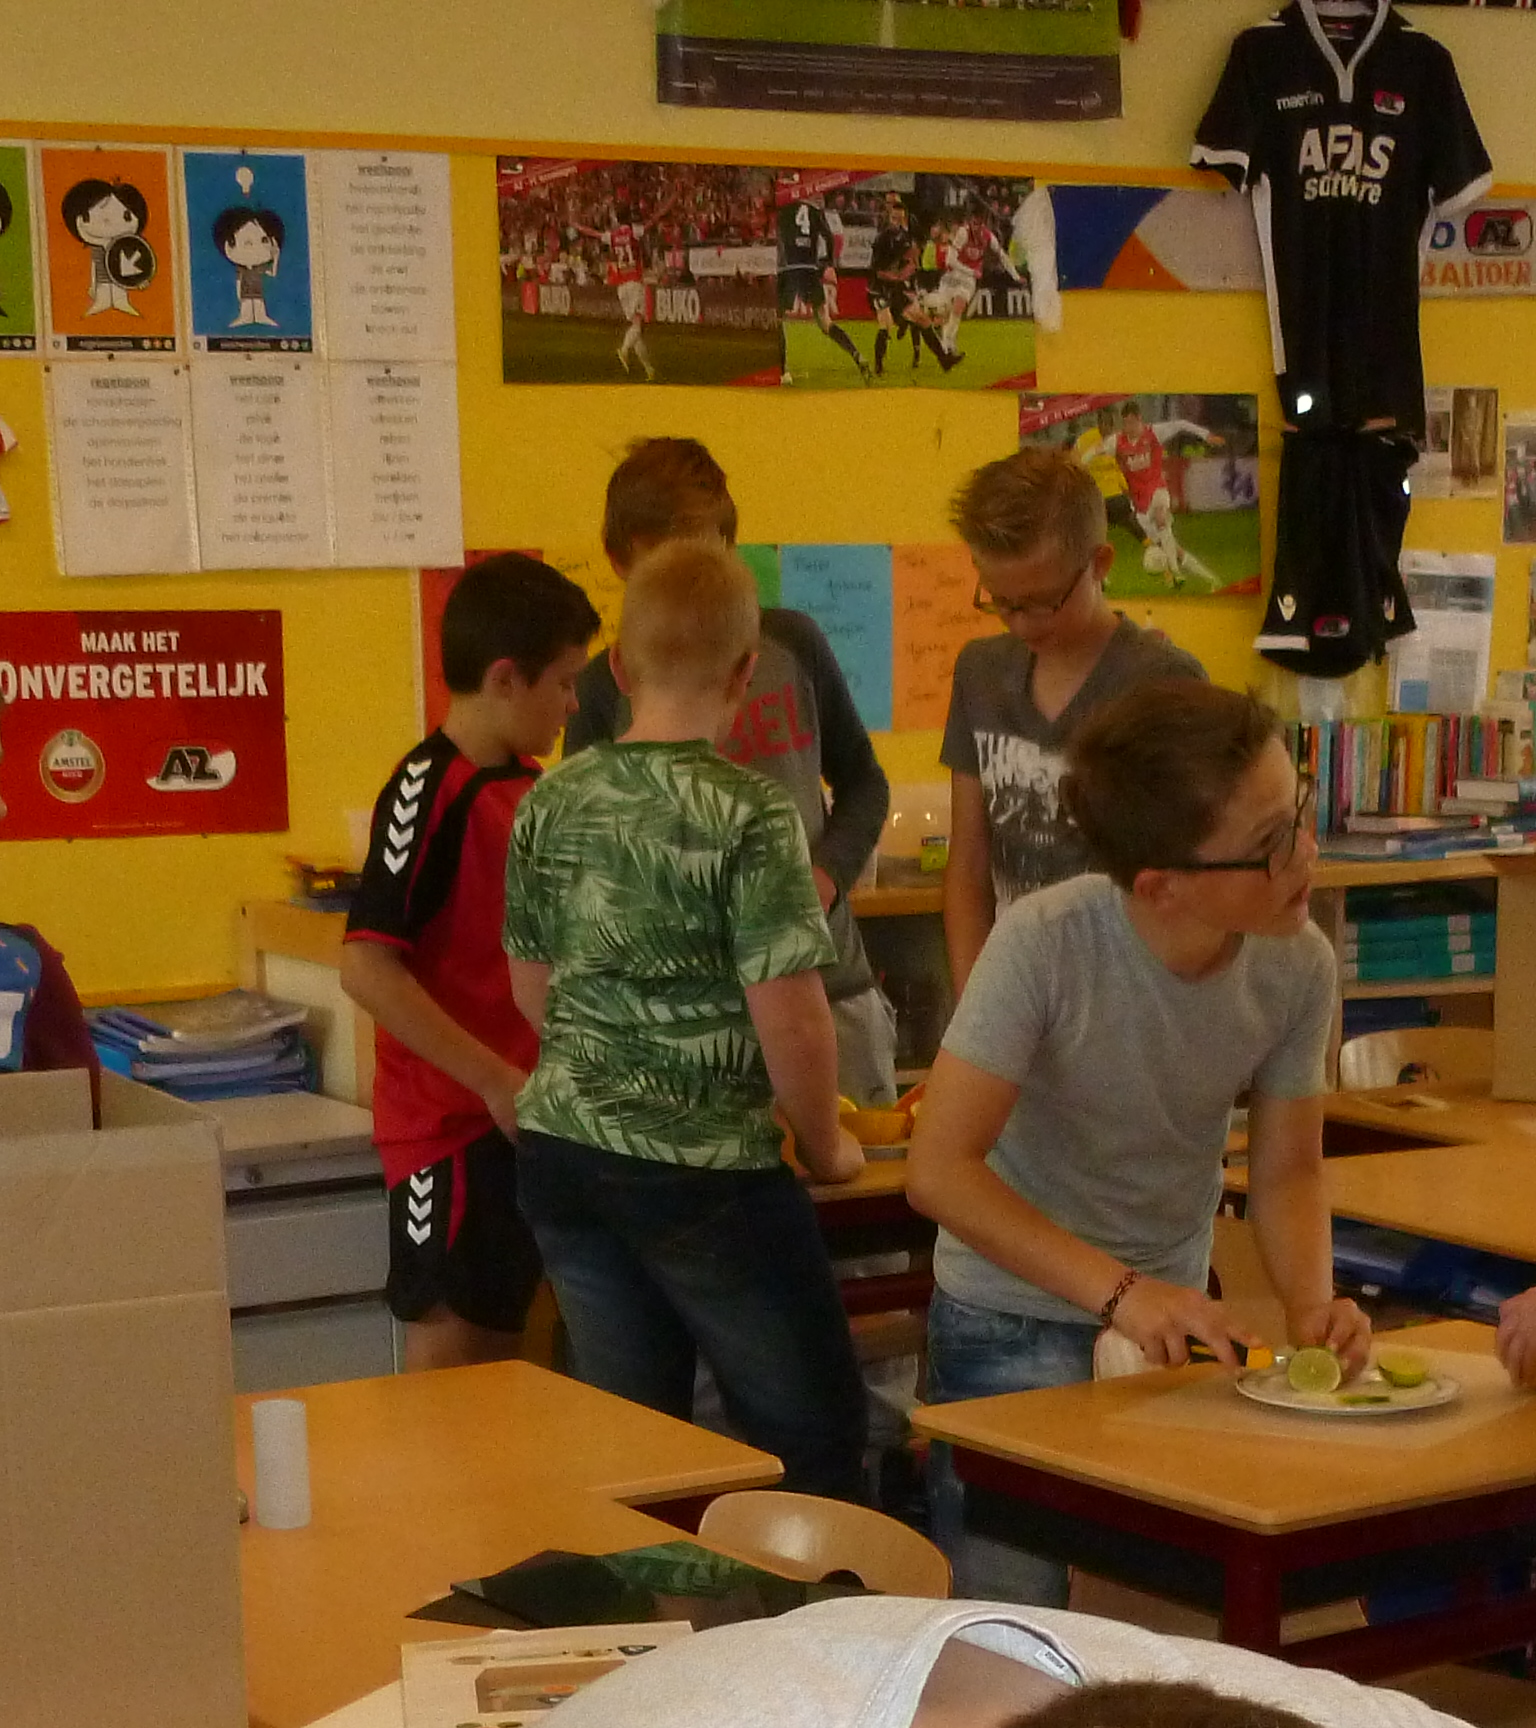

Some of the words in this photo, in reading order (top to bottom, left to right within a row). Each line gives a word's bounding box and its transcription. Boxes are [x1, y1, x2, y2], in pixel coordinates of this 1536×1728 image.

[655, 287, 701, 324] BUKO
[81, 631, 136, 653] MAAK
[142, 630, 180, 653] HET
[53, 756, 92, 768] AMSTEL
[159, 745, 220, 783] AZ
